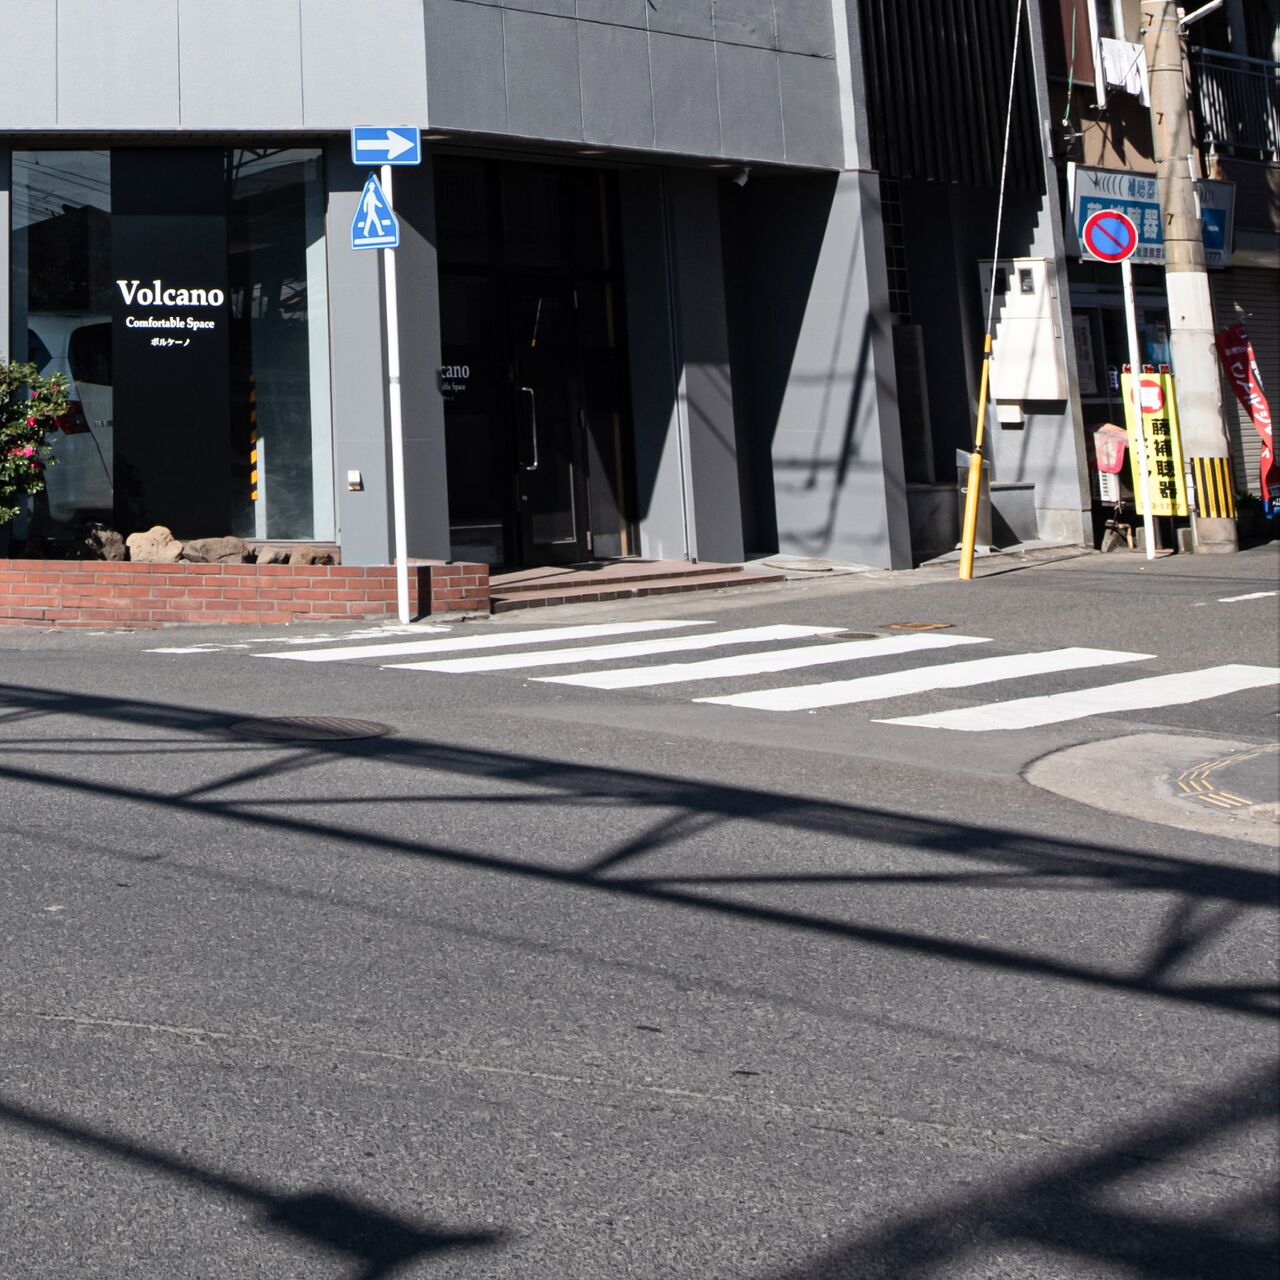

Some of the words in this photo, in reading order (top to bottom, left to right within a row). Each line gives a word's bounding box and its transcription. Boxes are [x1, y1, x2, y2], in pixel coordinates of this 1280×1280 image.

[116, 280, 224, 307] Volcano
[126, 316, 185, 329] Comfortable
[187, 317, 215, 331] Space
